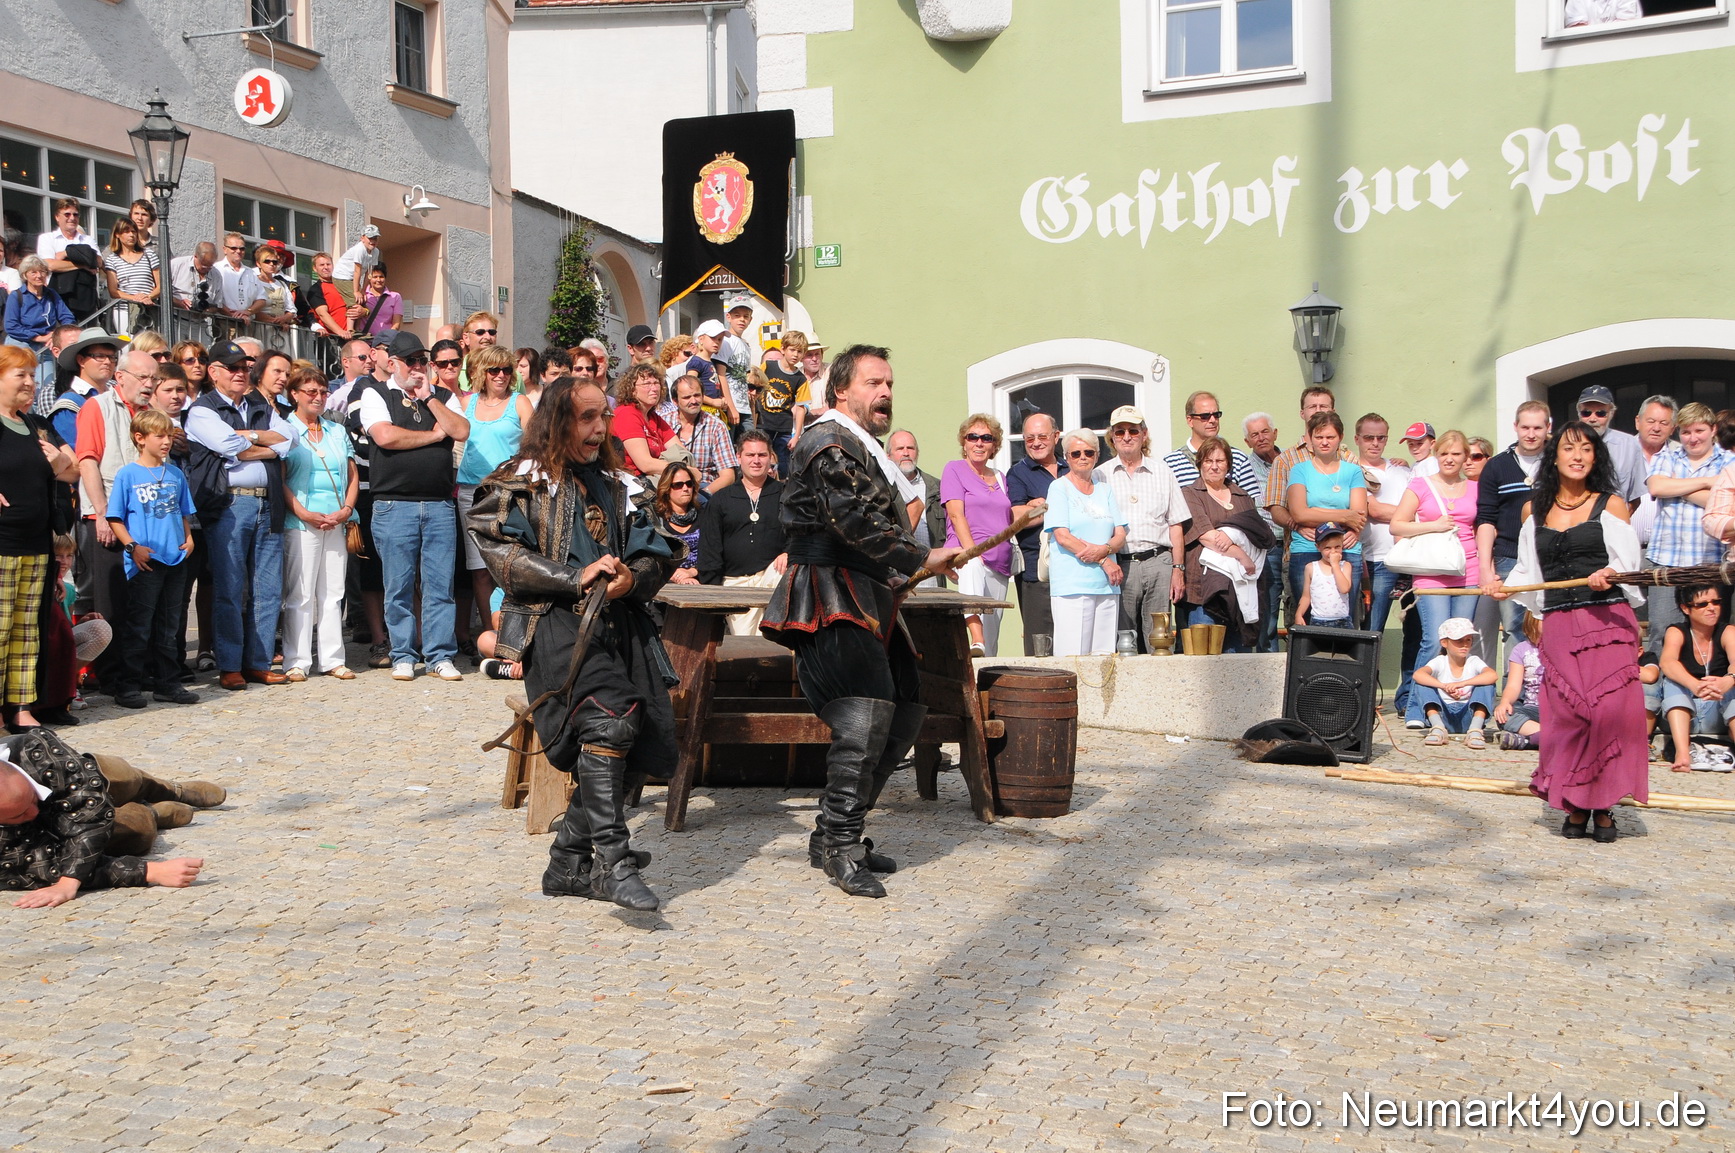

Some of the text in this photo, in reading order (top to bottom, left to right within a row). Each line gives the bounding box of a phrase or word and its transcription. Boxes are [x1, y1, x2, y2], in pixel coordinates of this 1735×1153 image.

[1334, 158, 1470, 233] zur
[1501, 113, 1701, 216] Post
[820, 246, 835, 258] 12
[137, 486, 158, 504] 86
